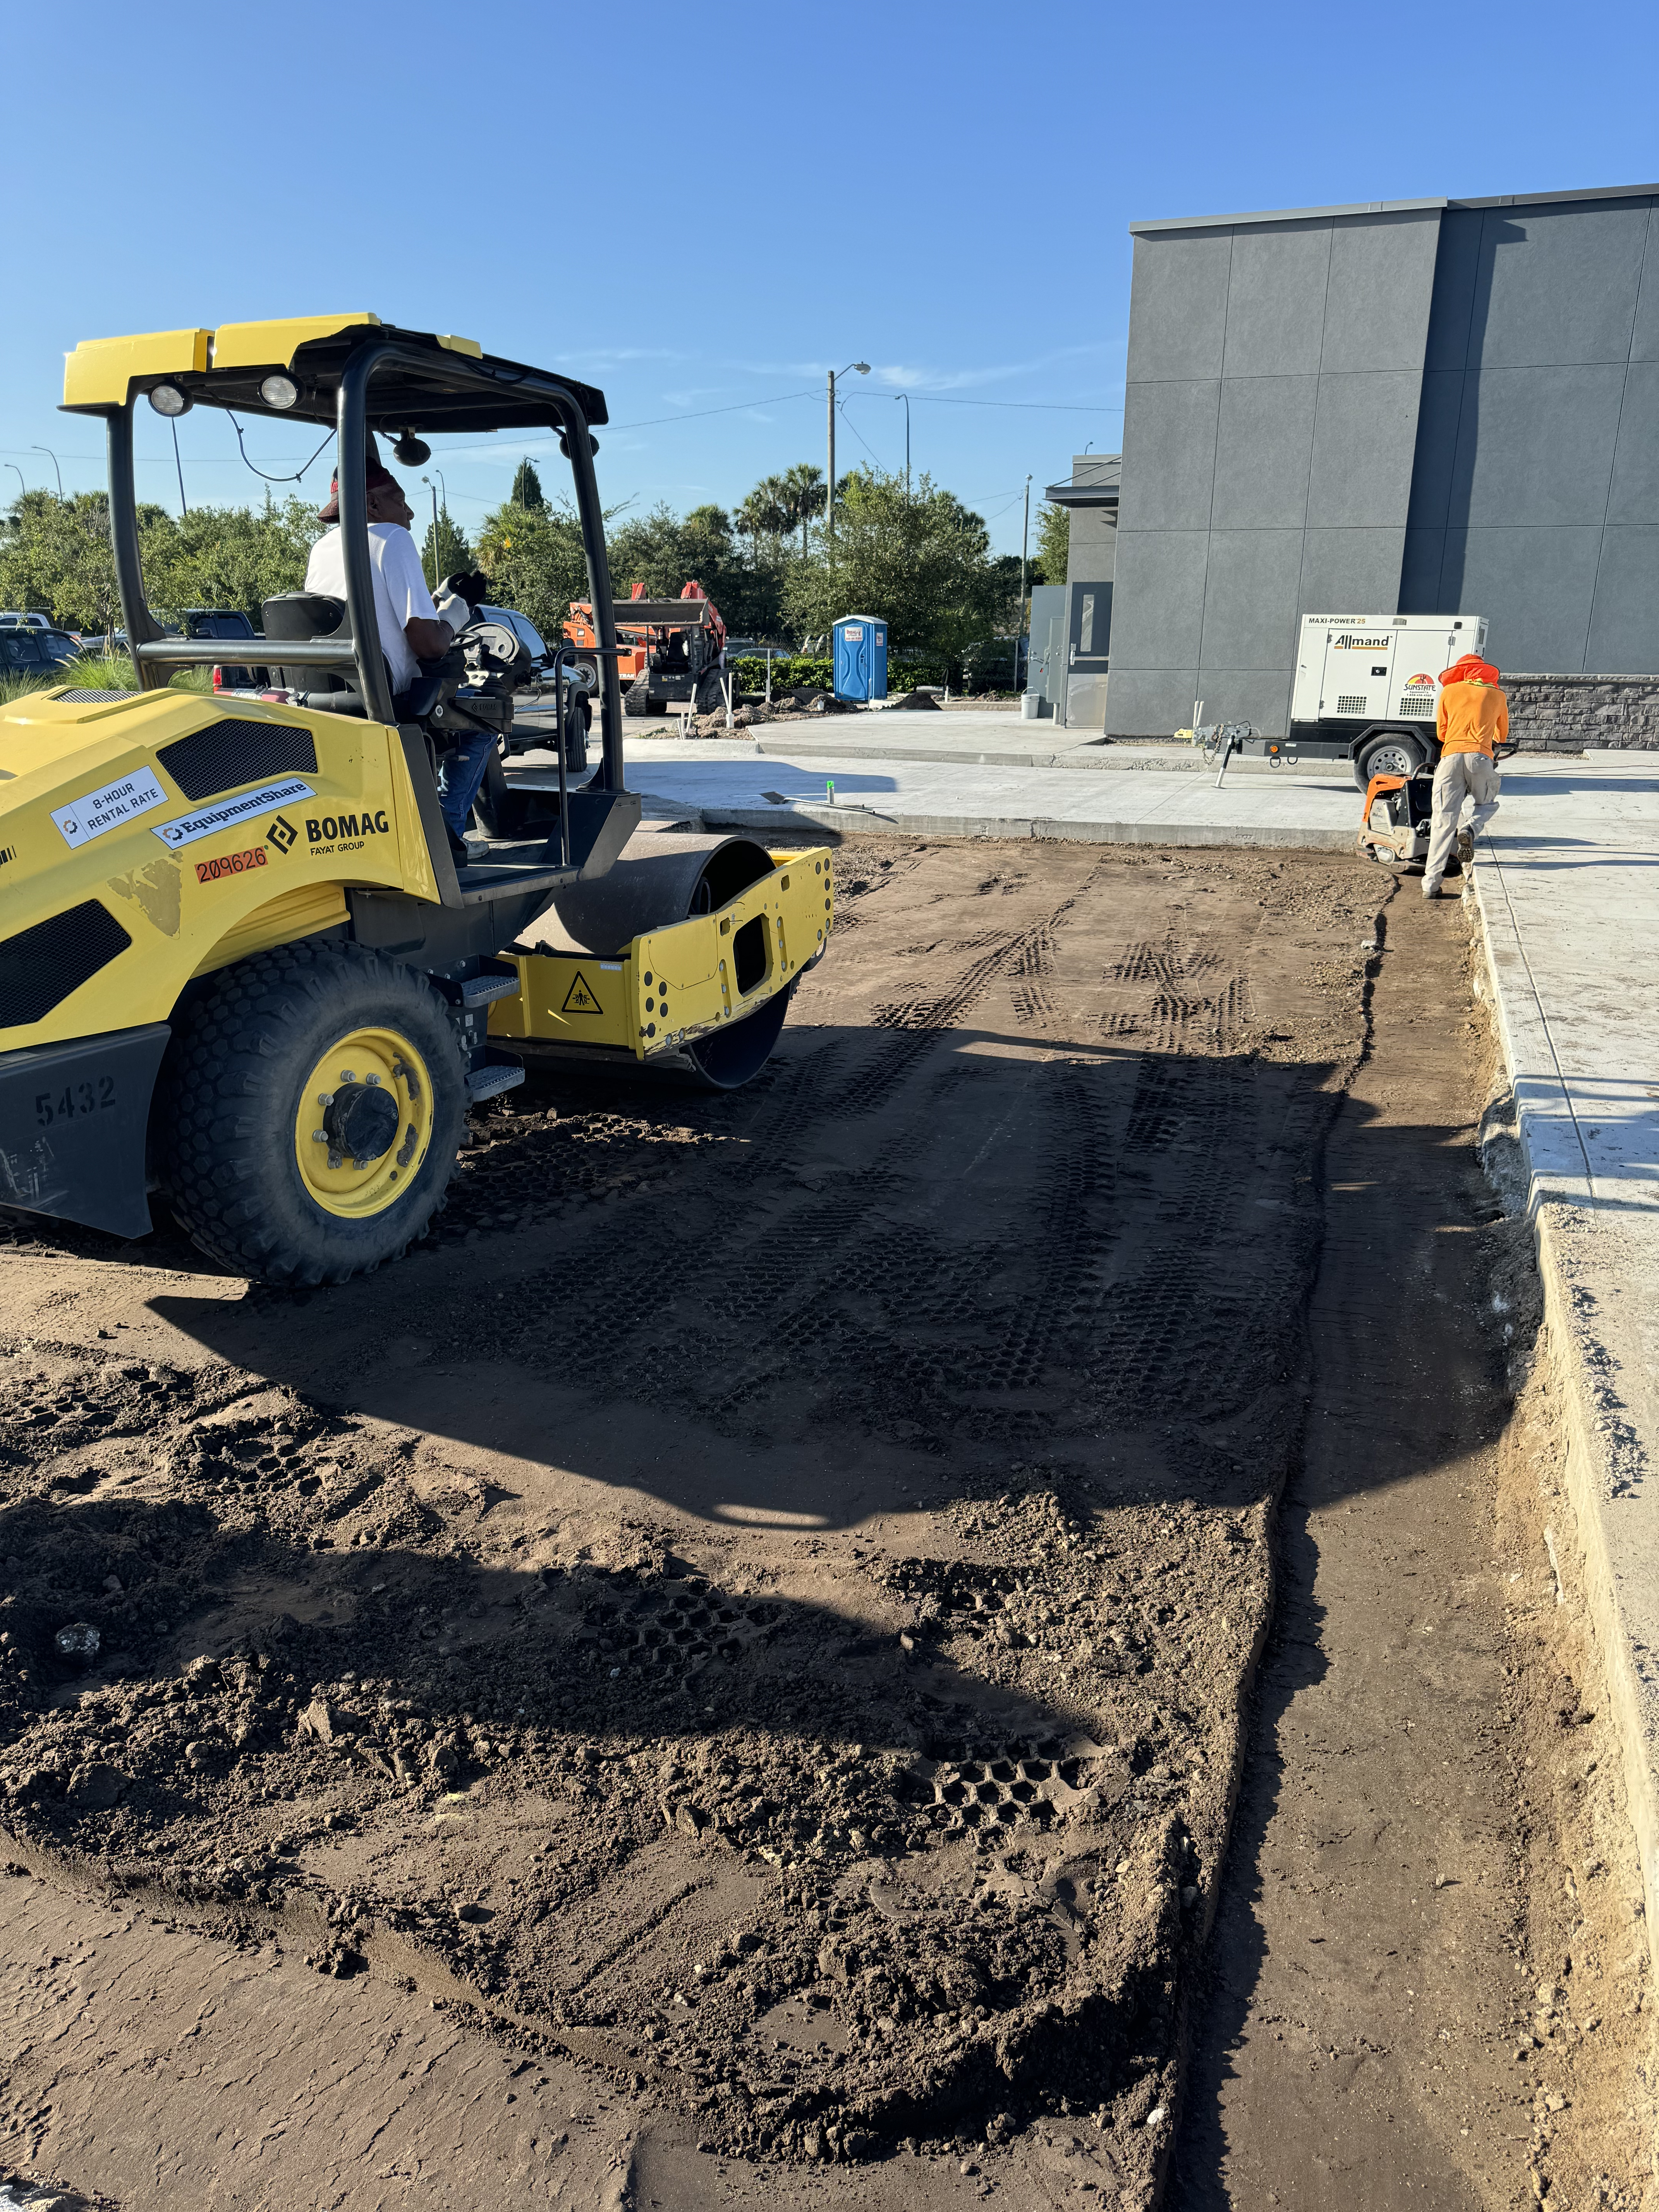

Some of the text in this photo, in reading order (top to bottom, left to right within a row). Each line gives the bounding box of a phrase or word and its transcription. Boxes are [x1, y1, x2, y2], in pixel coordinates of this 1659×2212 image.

[1334, 635, 1389, 649] Allmand
[87, 788, 158, 830] RENTAL RATE
[93, 783, 135, 809] 8-HOUR
[180, 782, 307, 833] EquipmentShare
[305, 811, 389, 843] BOMAG
[197, 847, 266, 883] 209626
[310, 841, 364, 856] FAYAT GROUP
[35, 1076, 116, 1126] 5432
